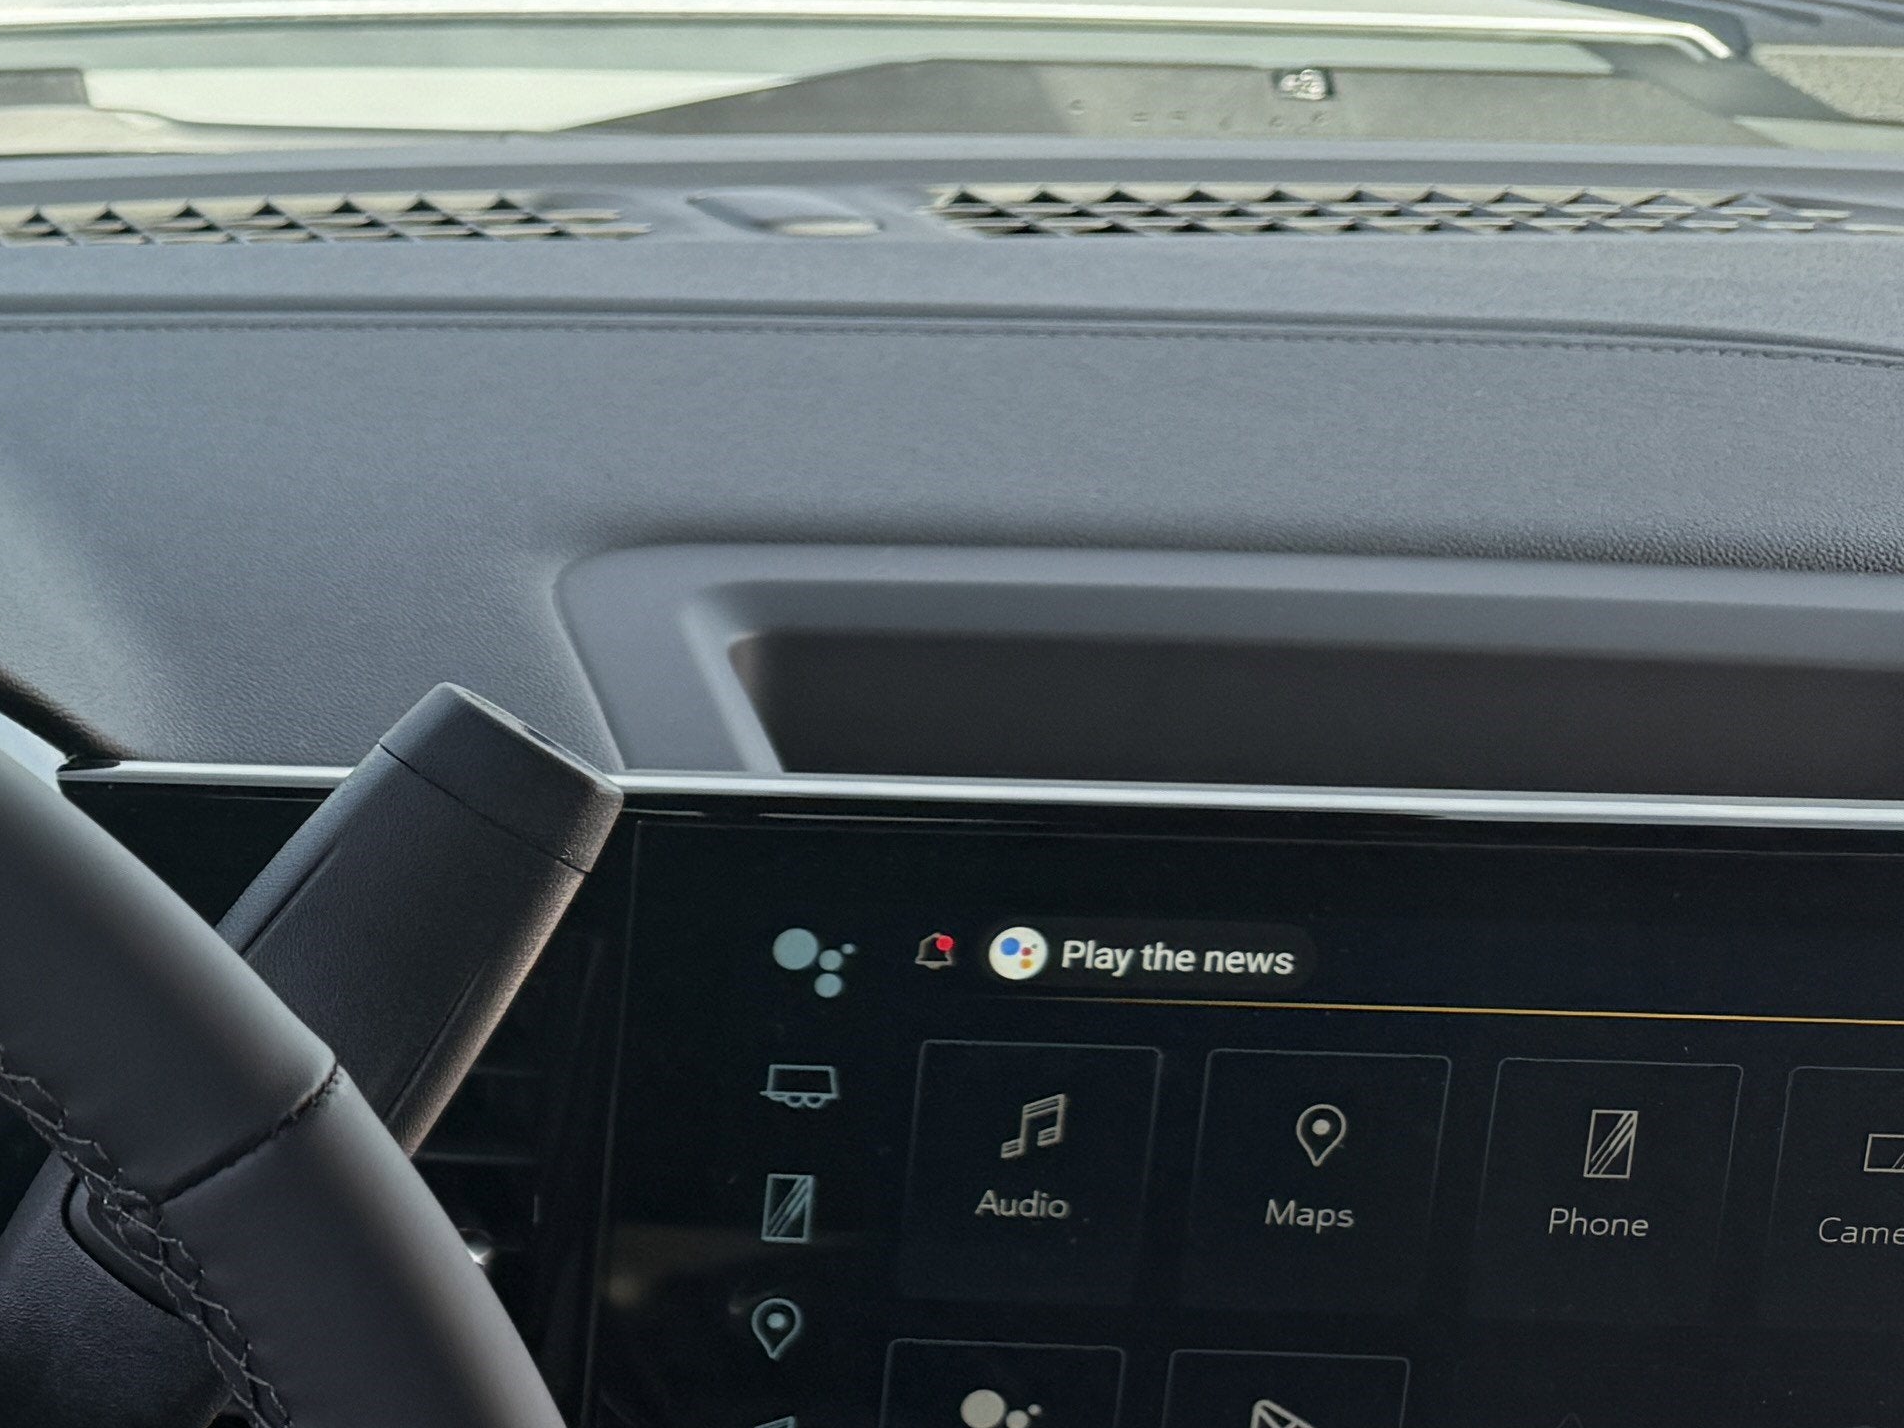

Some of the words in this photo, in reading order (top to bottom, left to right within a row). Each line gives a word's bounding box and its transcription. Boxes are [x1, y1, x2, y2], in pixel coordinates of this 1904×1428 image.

[1062, 939, 1127, 978] Play
[1142, 943, 1195, 972] the
[1203, 950, 1294, 975] news
[975, 1190, 1071, 1220] Audio
[1265, 1199, 1355, 1233] Maps
[1548, 1207, 1650, 1238] Phone
